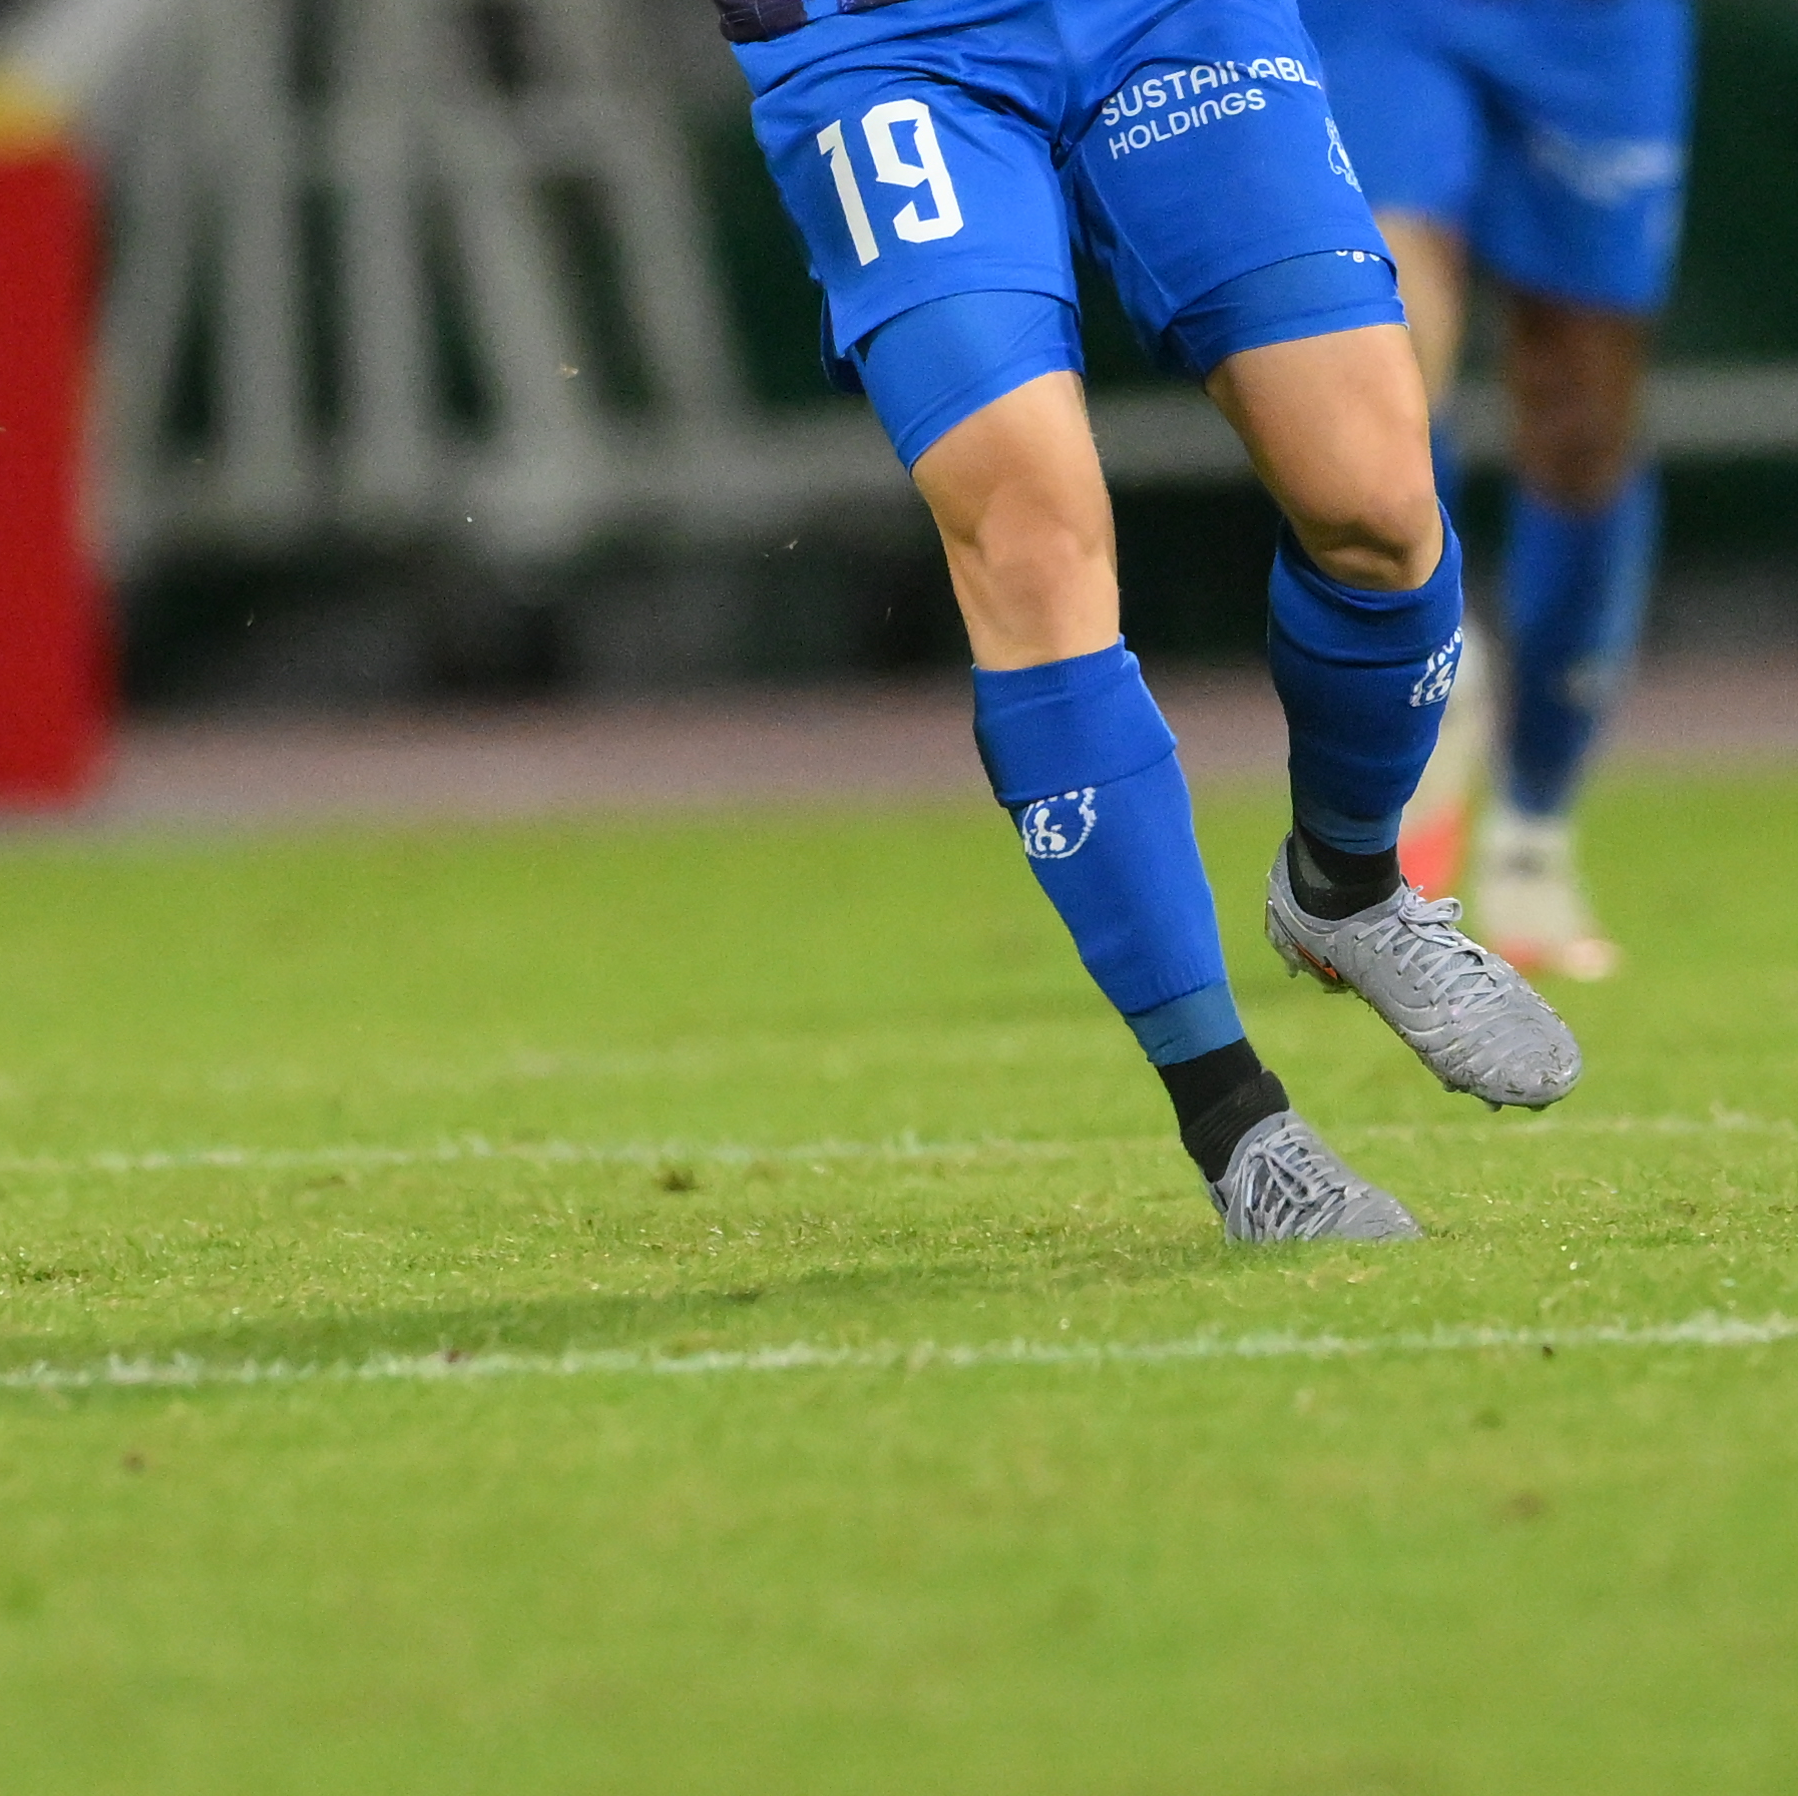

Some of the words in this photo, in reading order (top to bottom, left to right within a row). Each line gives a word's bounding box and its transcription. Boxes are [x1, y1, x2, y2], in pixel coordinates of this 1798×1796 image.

[1102, 57, 1321, 126] SUSTAINABL
[1108, 88, 1267, 160] HOLDINGS
[817, 98, 964, 267] 19
